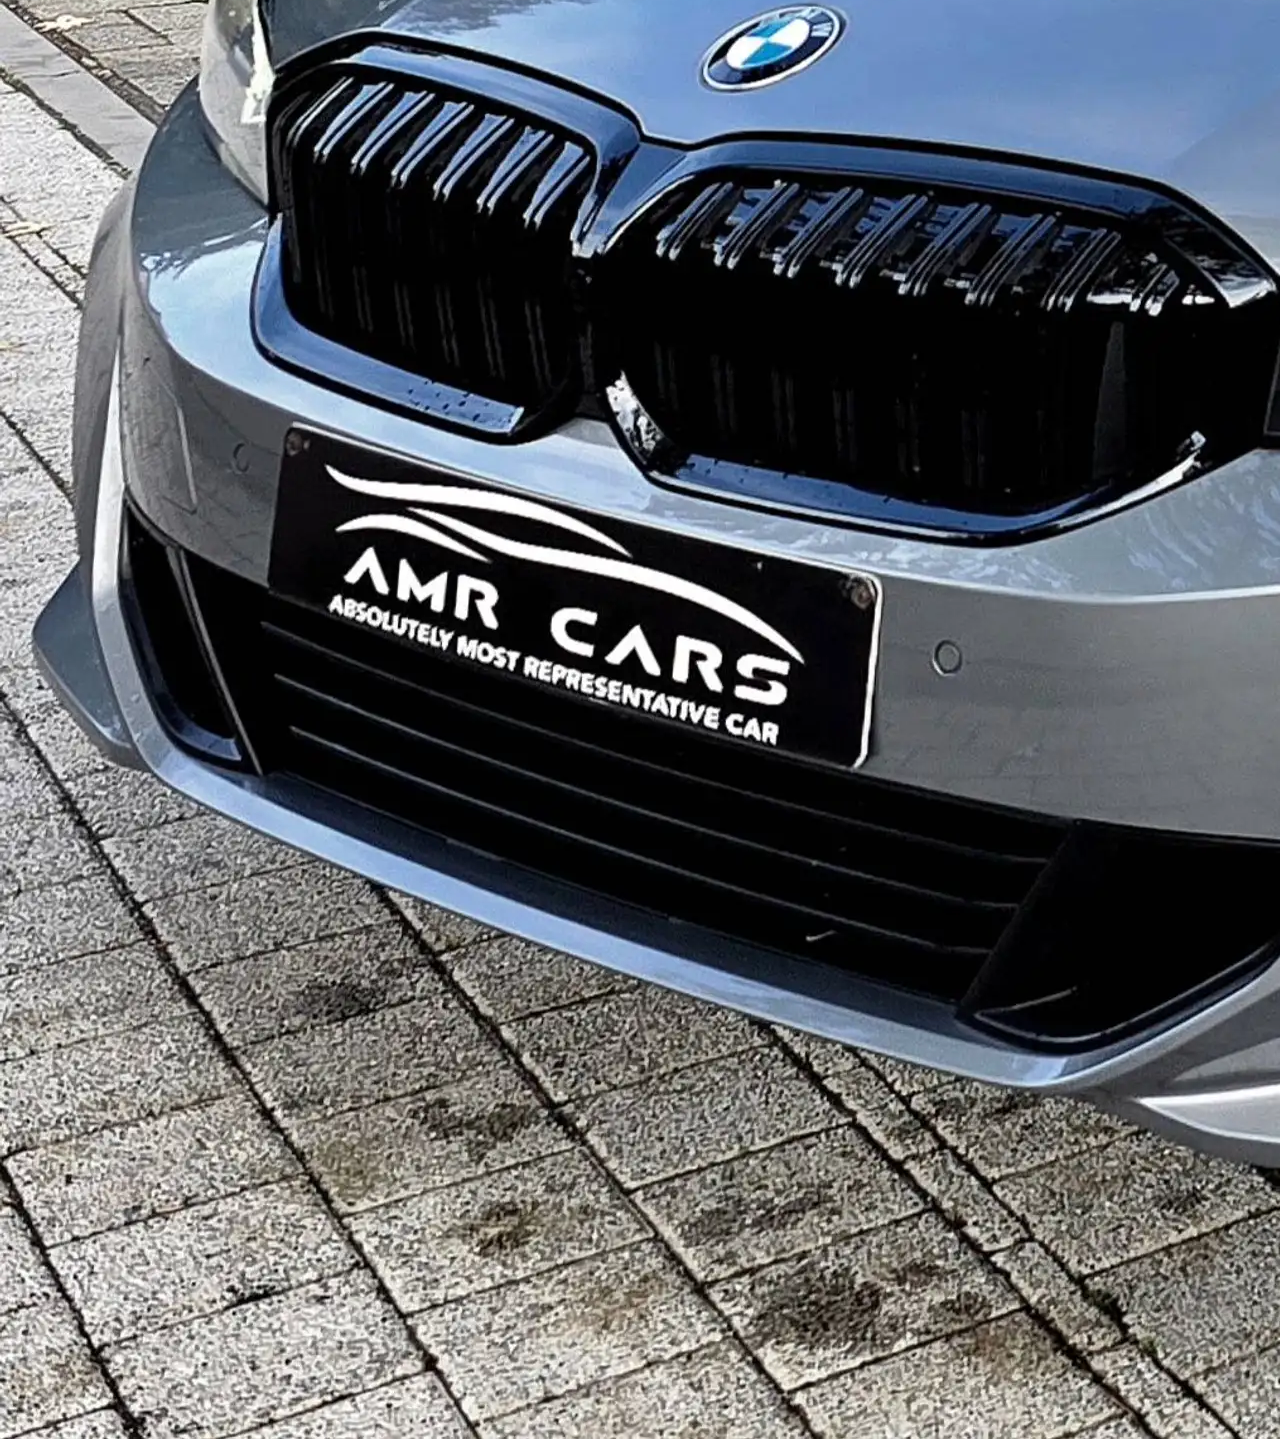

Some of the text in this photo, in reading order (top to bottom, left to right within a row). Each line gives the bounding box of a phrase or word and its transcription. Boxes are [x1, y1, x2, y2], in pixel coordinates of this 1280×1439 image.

[327, 593, 780, 746] ABSOLUTELY MOST REPRESENTATIVE CAR
[343, 546, 791, 706] AMR CARS
